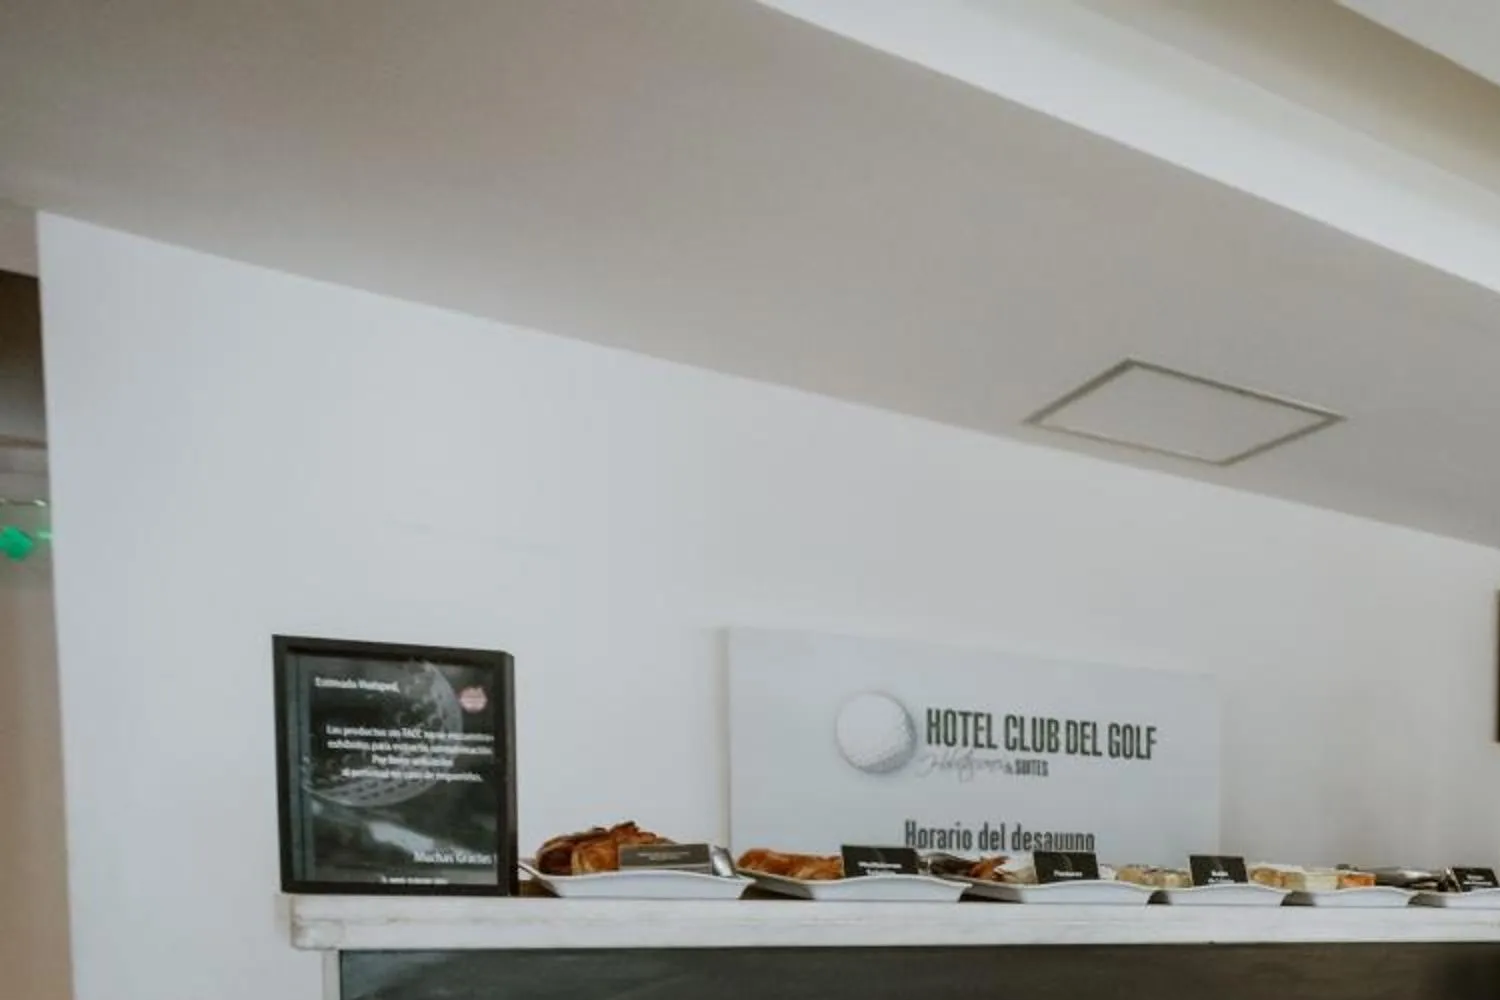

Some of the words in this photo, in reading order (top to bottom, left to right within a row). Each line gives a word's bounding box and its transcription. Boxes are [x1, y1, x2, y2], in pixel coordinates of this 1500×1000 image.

[326, 724, 342, 735] Los
[343, 727, 386, 738] productos
[926, 708, 997, 749] HOTEL
[1004, 714, 1060, 753] CLUB
[1064, 719, 1103, 756] DEL
[1107, 722, 1157, 760] GOLF
[1015, 758, 1049, 777] SUITES
[904, 820, 973, 851] Horario
[978, 821, 1006, 851] del
[413, 850, 455, 865] Muchas
[456, 851, 493, 865] Gracias
